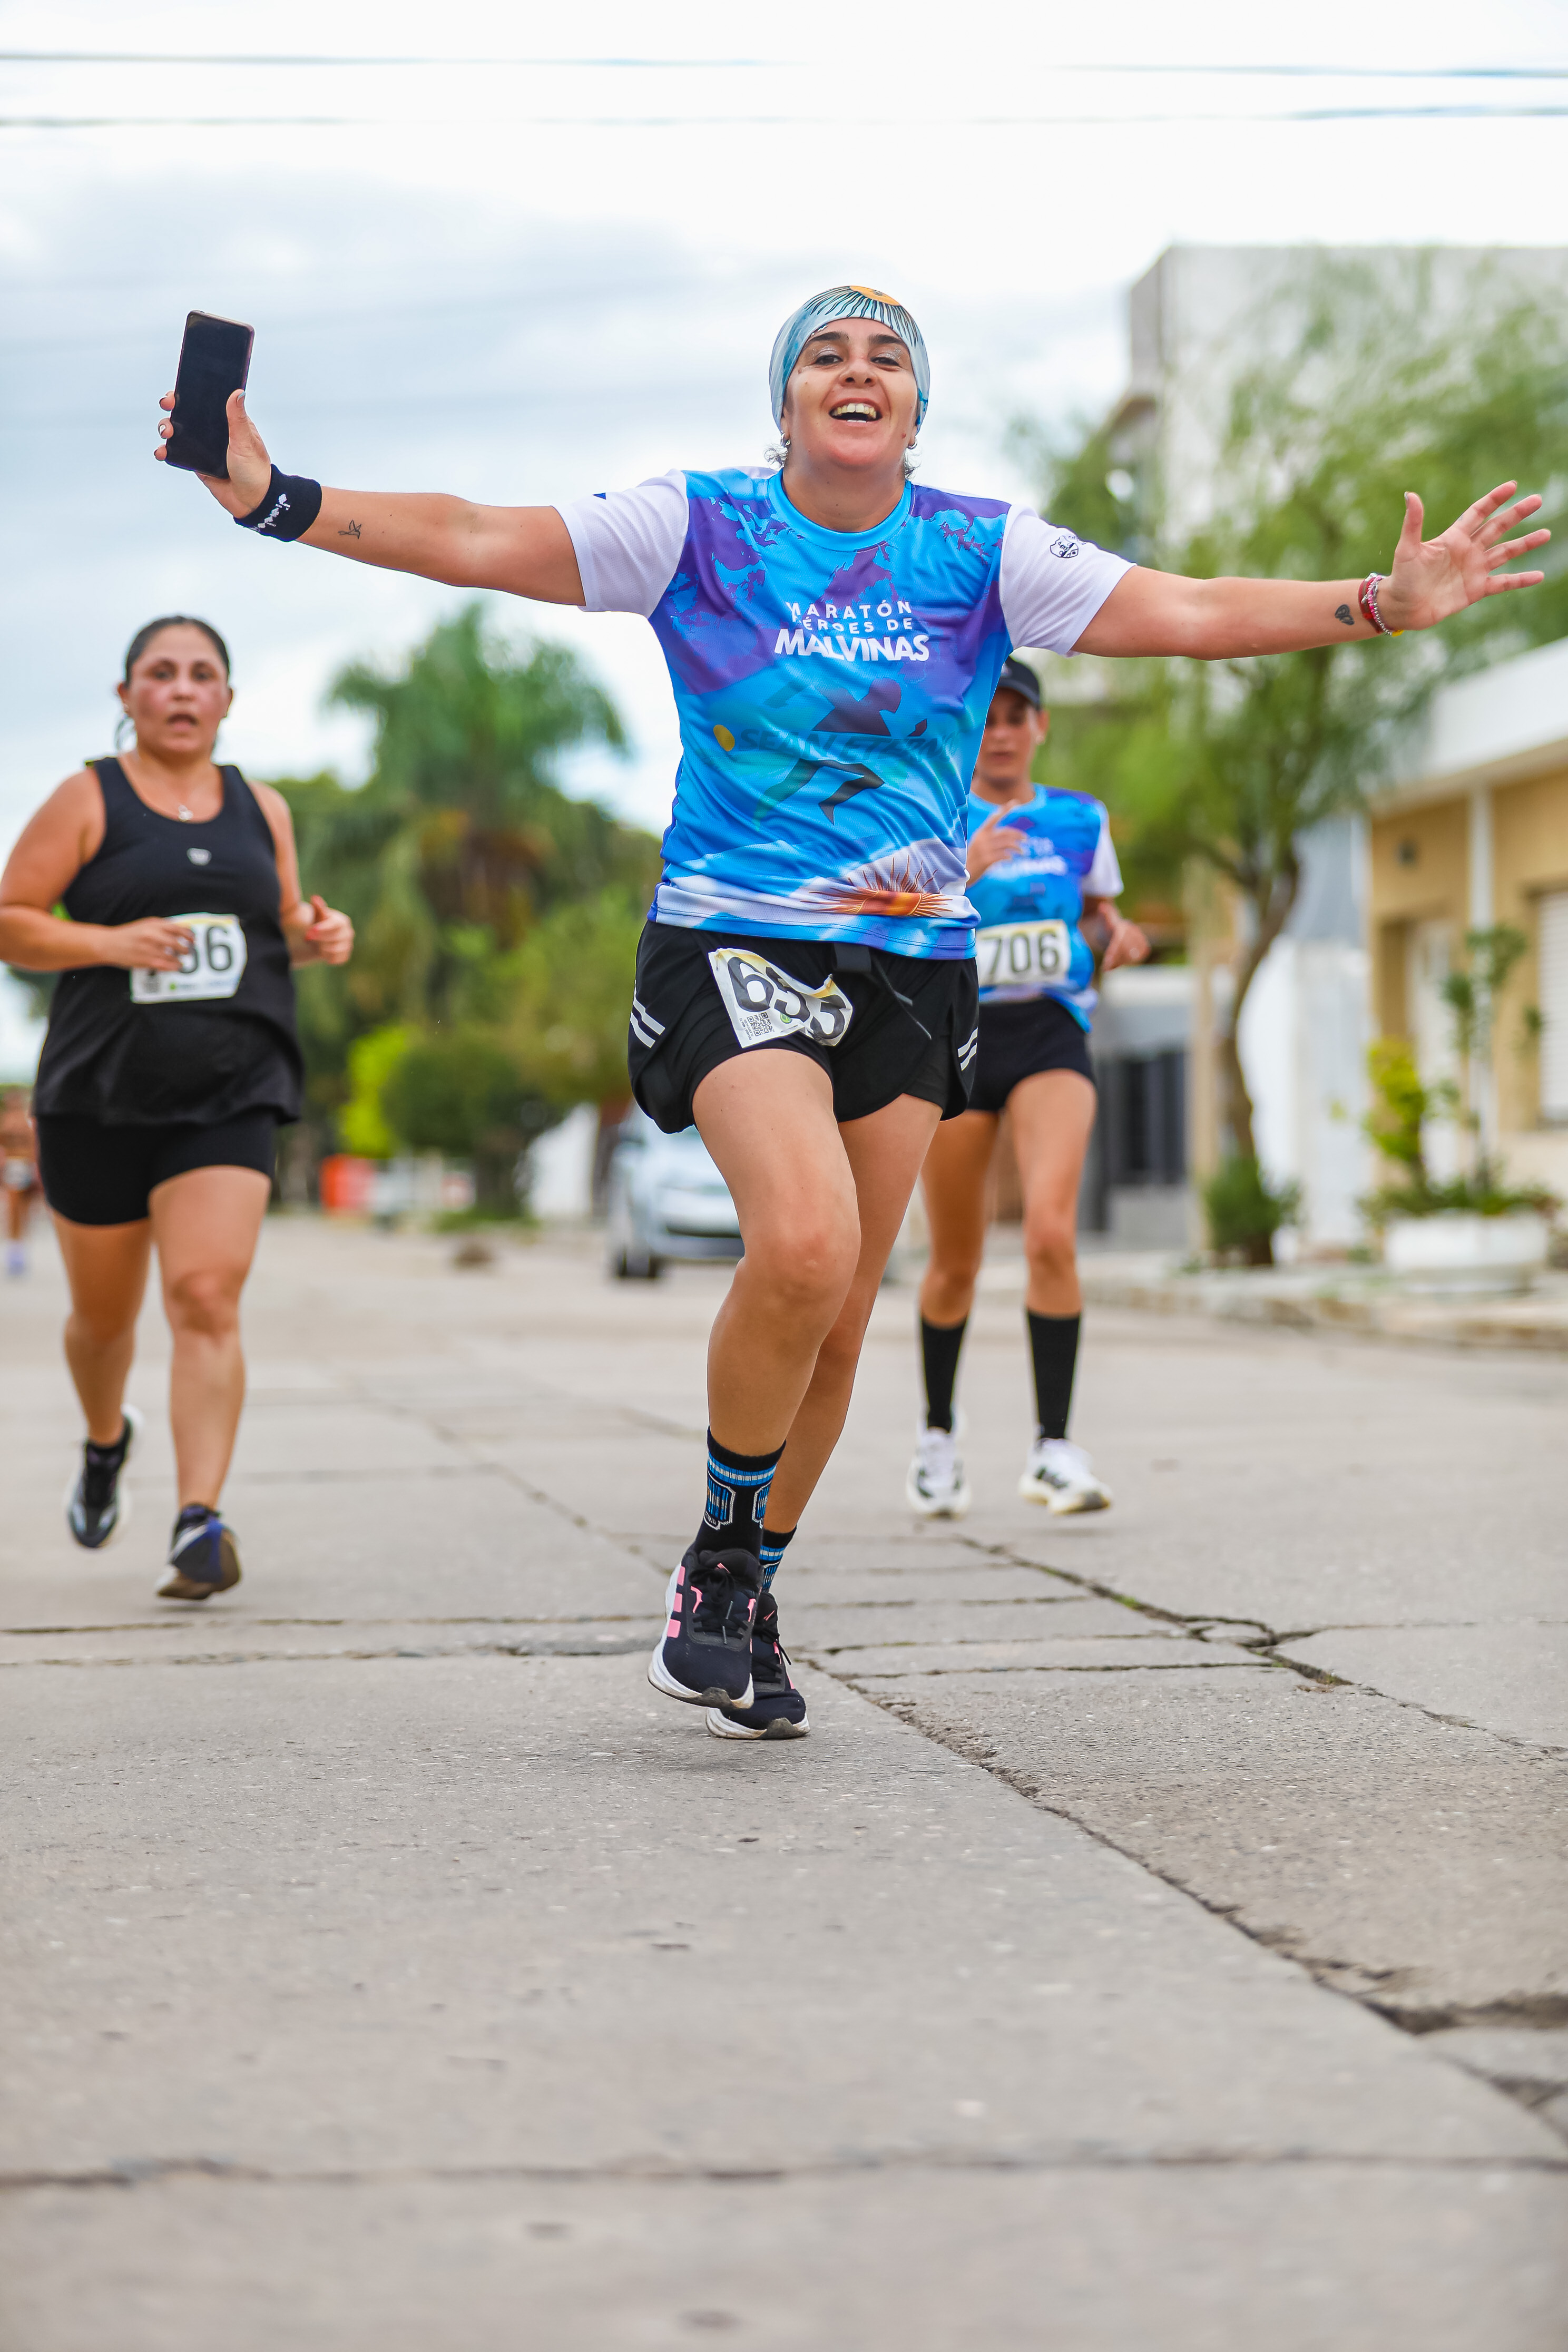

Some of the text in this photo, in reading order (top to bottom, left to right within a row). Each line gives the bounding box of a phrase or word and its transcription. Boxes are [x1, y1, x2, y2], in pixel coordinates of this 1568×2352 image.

[786, 600, 912, 620] MARATÓN
[887, 618, 913, 630] DE
[774, 629, 929, 661] MALVINAS
[983, 928, 1059, 984] 706
